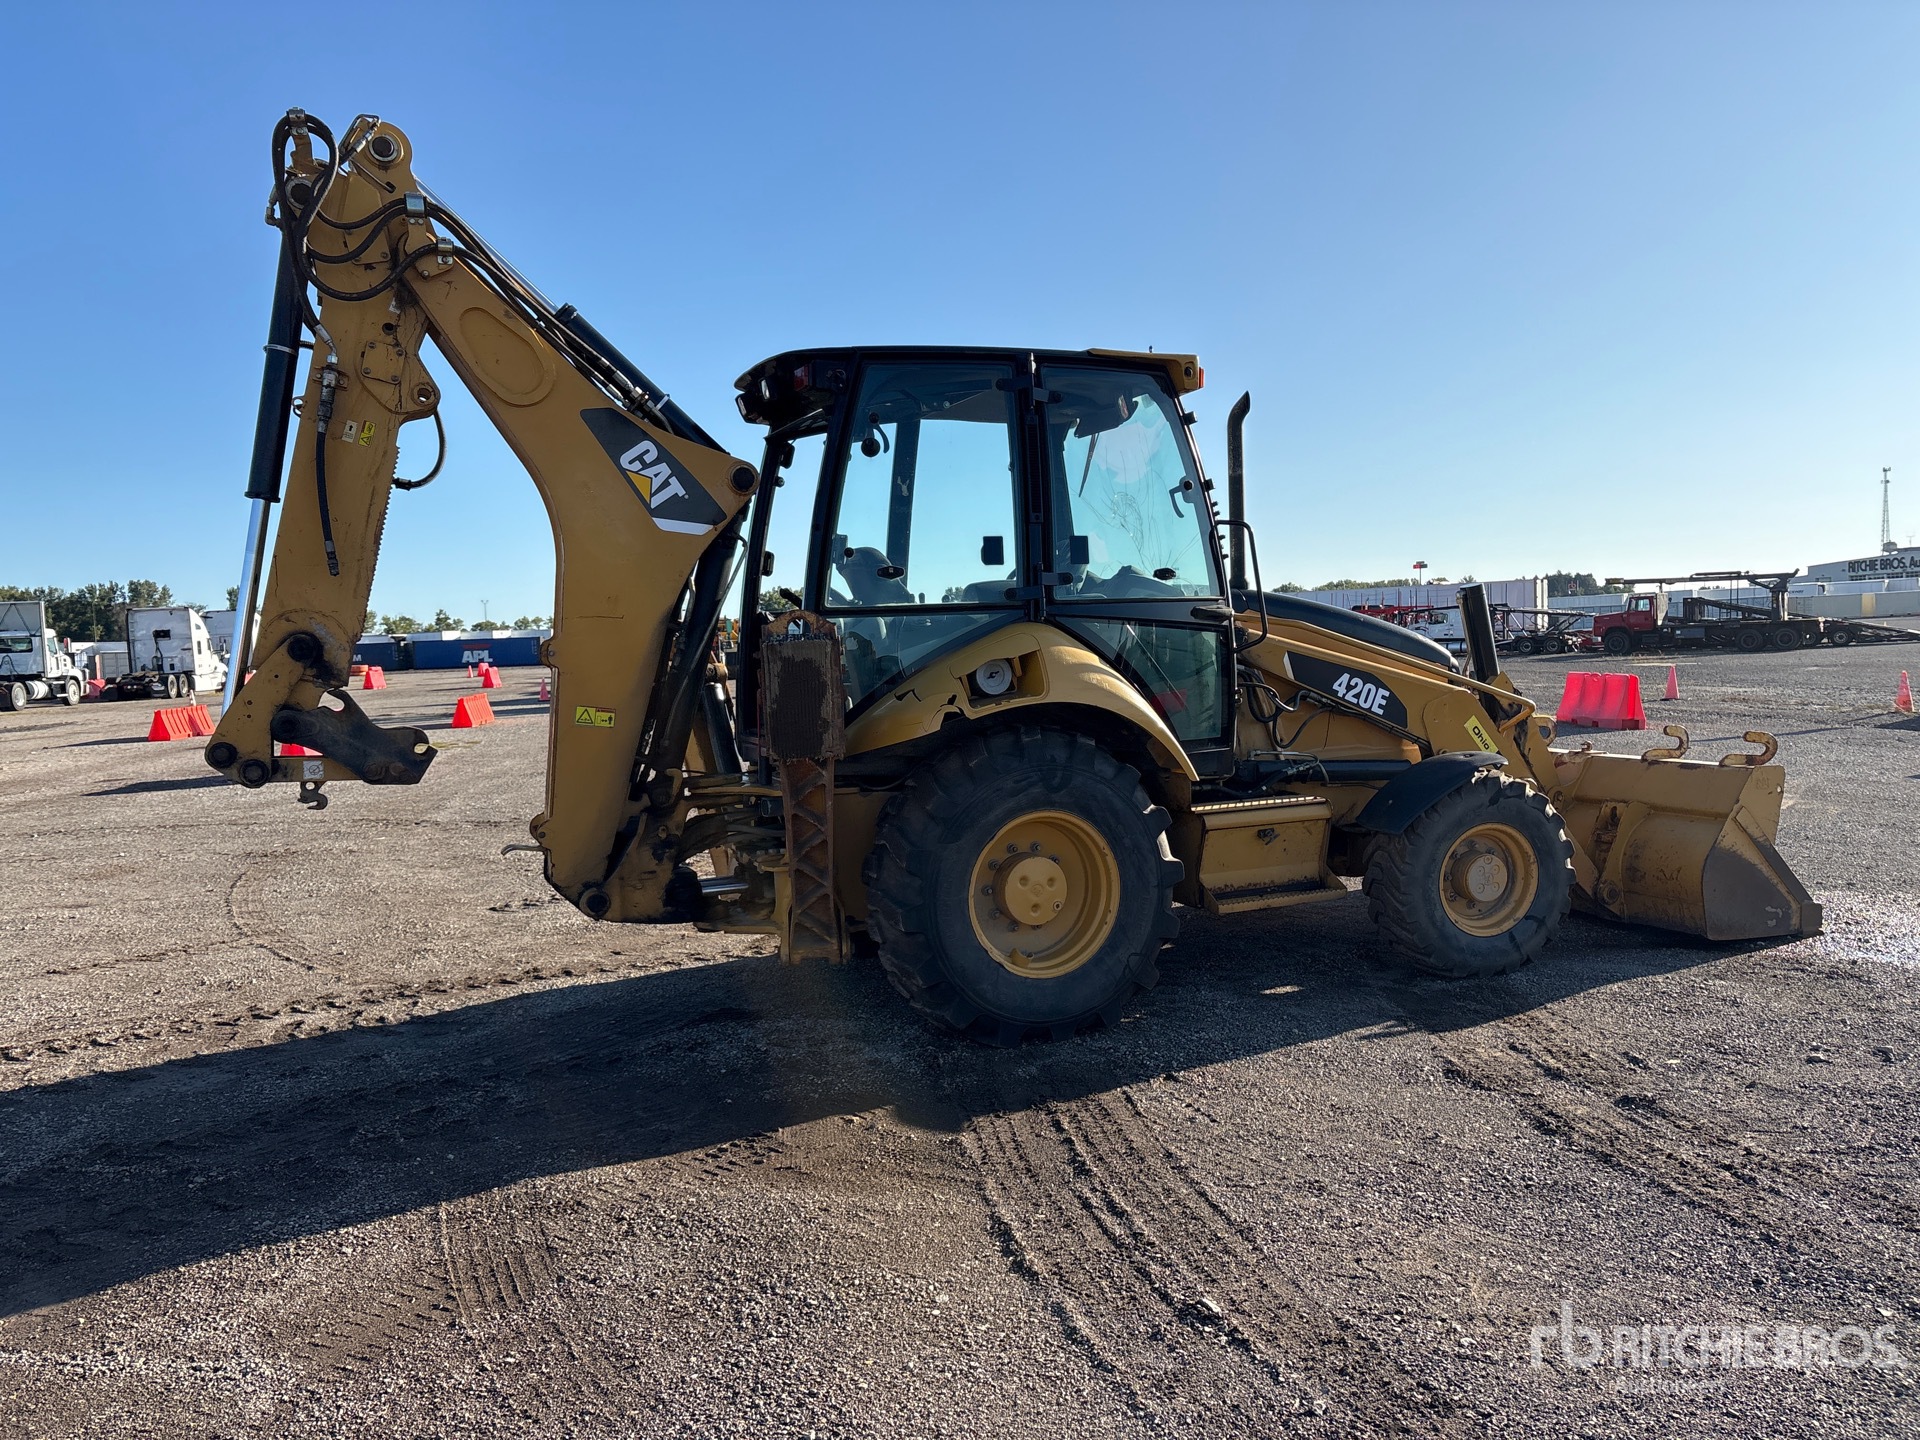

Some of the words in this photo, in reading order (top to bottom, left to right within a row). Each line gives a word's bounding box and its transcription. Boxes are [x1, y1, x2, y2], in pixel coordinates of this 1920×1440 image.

[619, 440, 687, 509] CAT
[1848, 559, 1879, 573] RITCHIE
[461, 650, 494, 663] APL
[1332, 672, 1390, 716] 420E
[1472, 725, 1490, 750] Ohio
